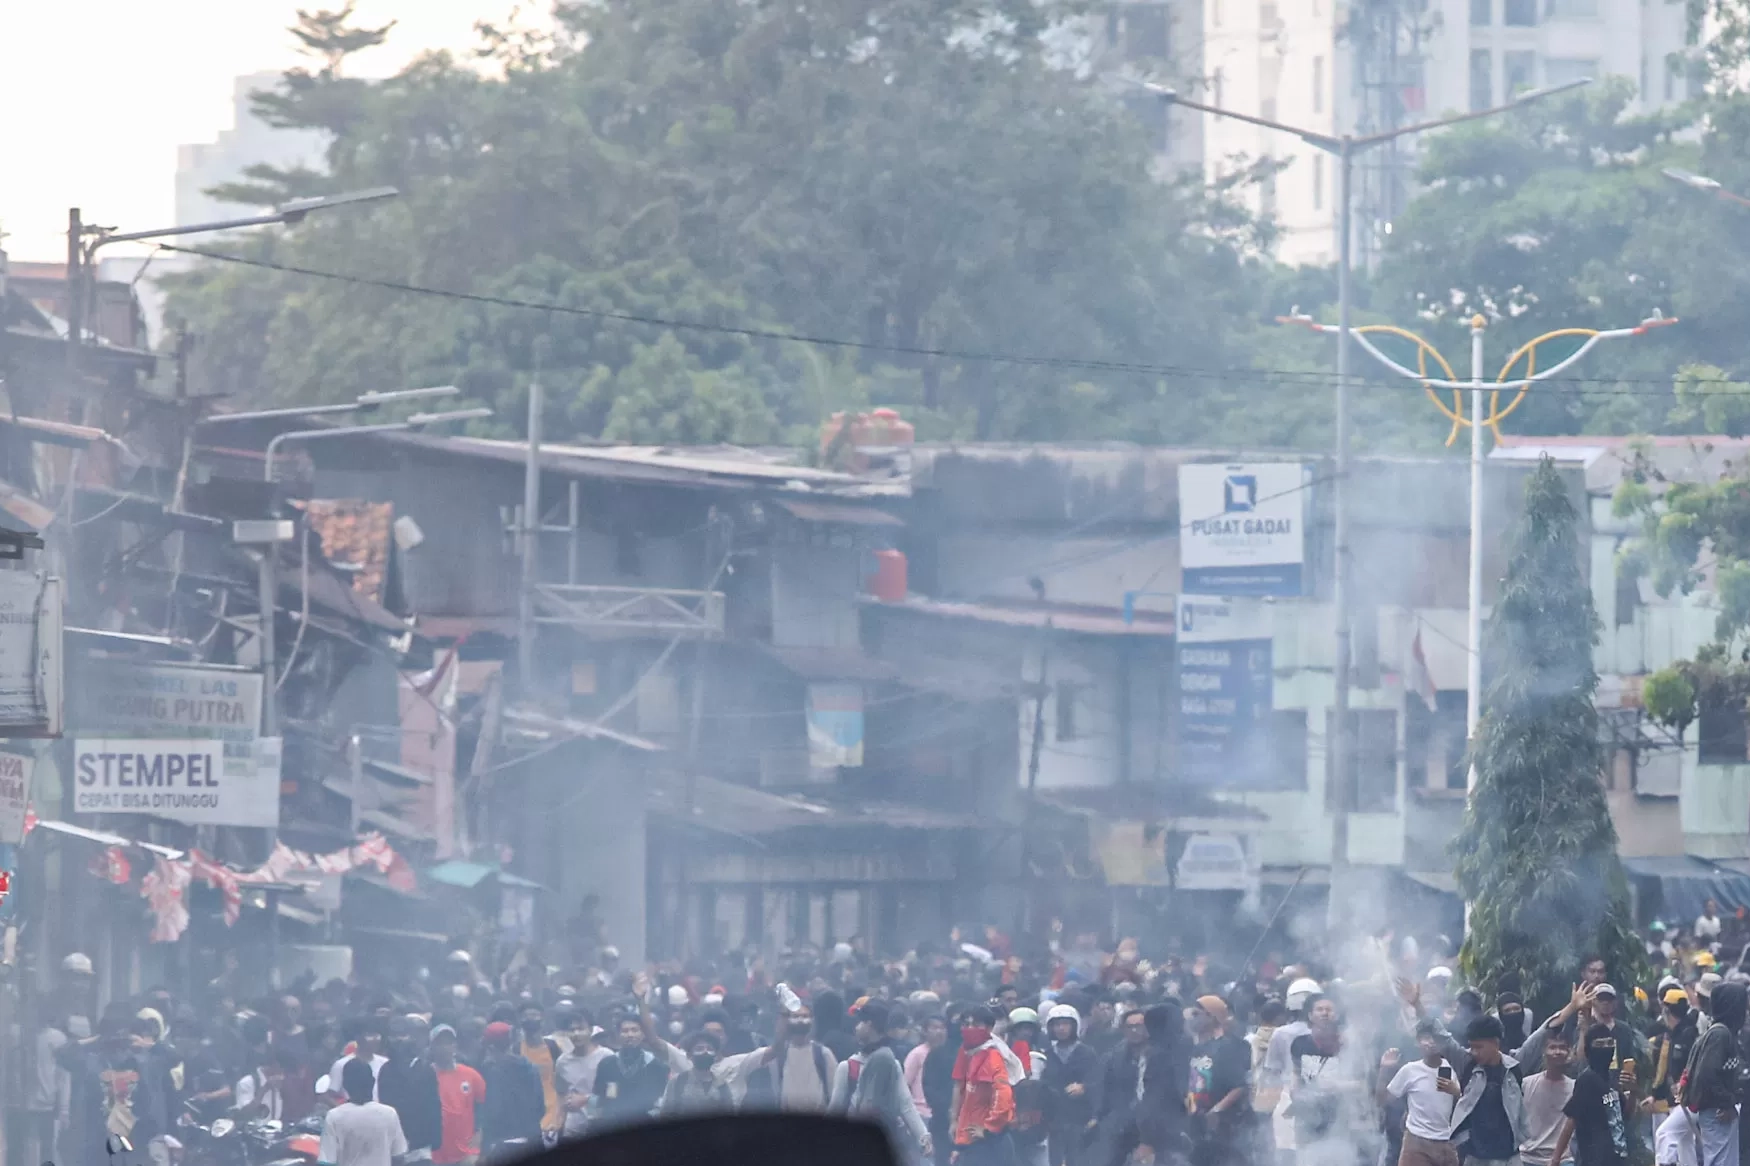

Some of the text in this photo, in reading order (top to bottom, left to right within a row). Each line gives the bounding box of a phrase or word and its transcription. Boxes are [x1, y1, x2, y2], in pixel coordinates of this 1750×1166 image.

[1191, 518, 1292, 536] PUSAT GADAI
[174, 699, 246, 724] PUTRA
[78, 752, 220, 788] STEMPEL
[79, 792, 219, 809] CEPAT BISA DITUNGGU
